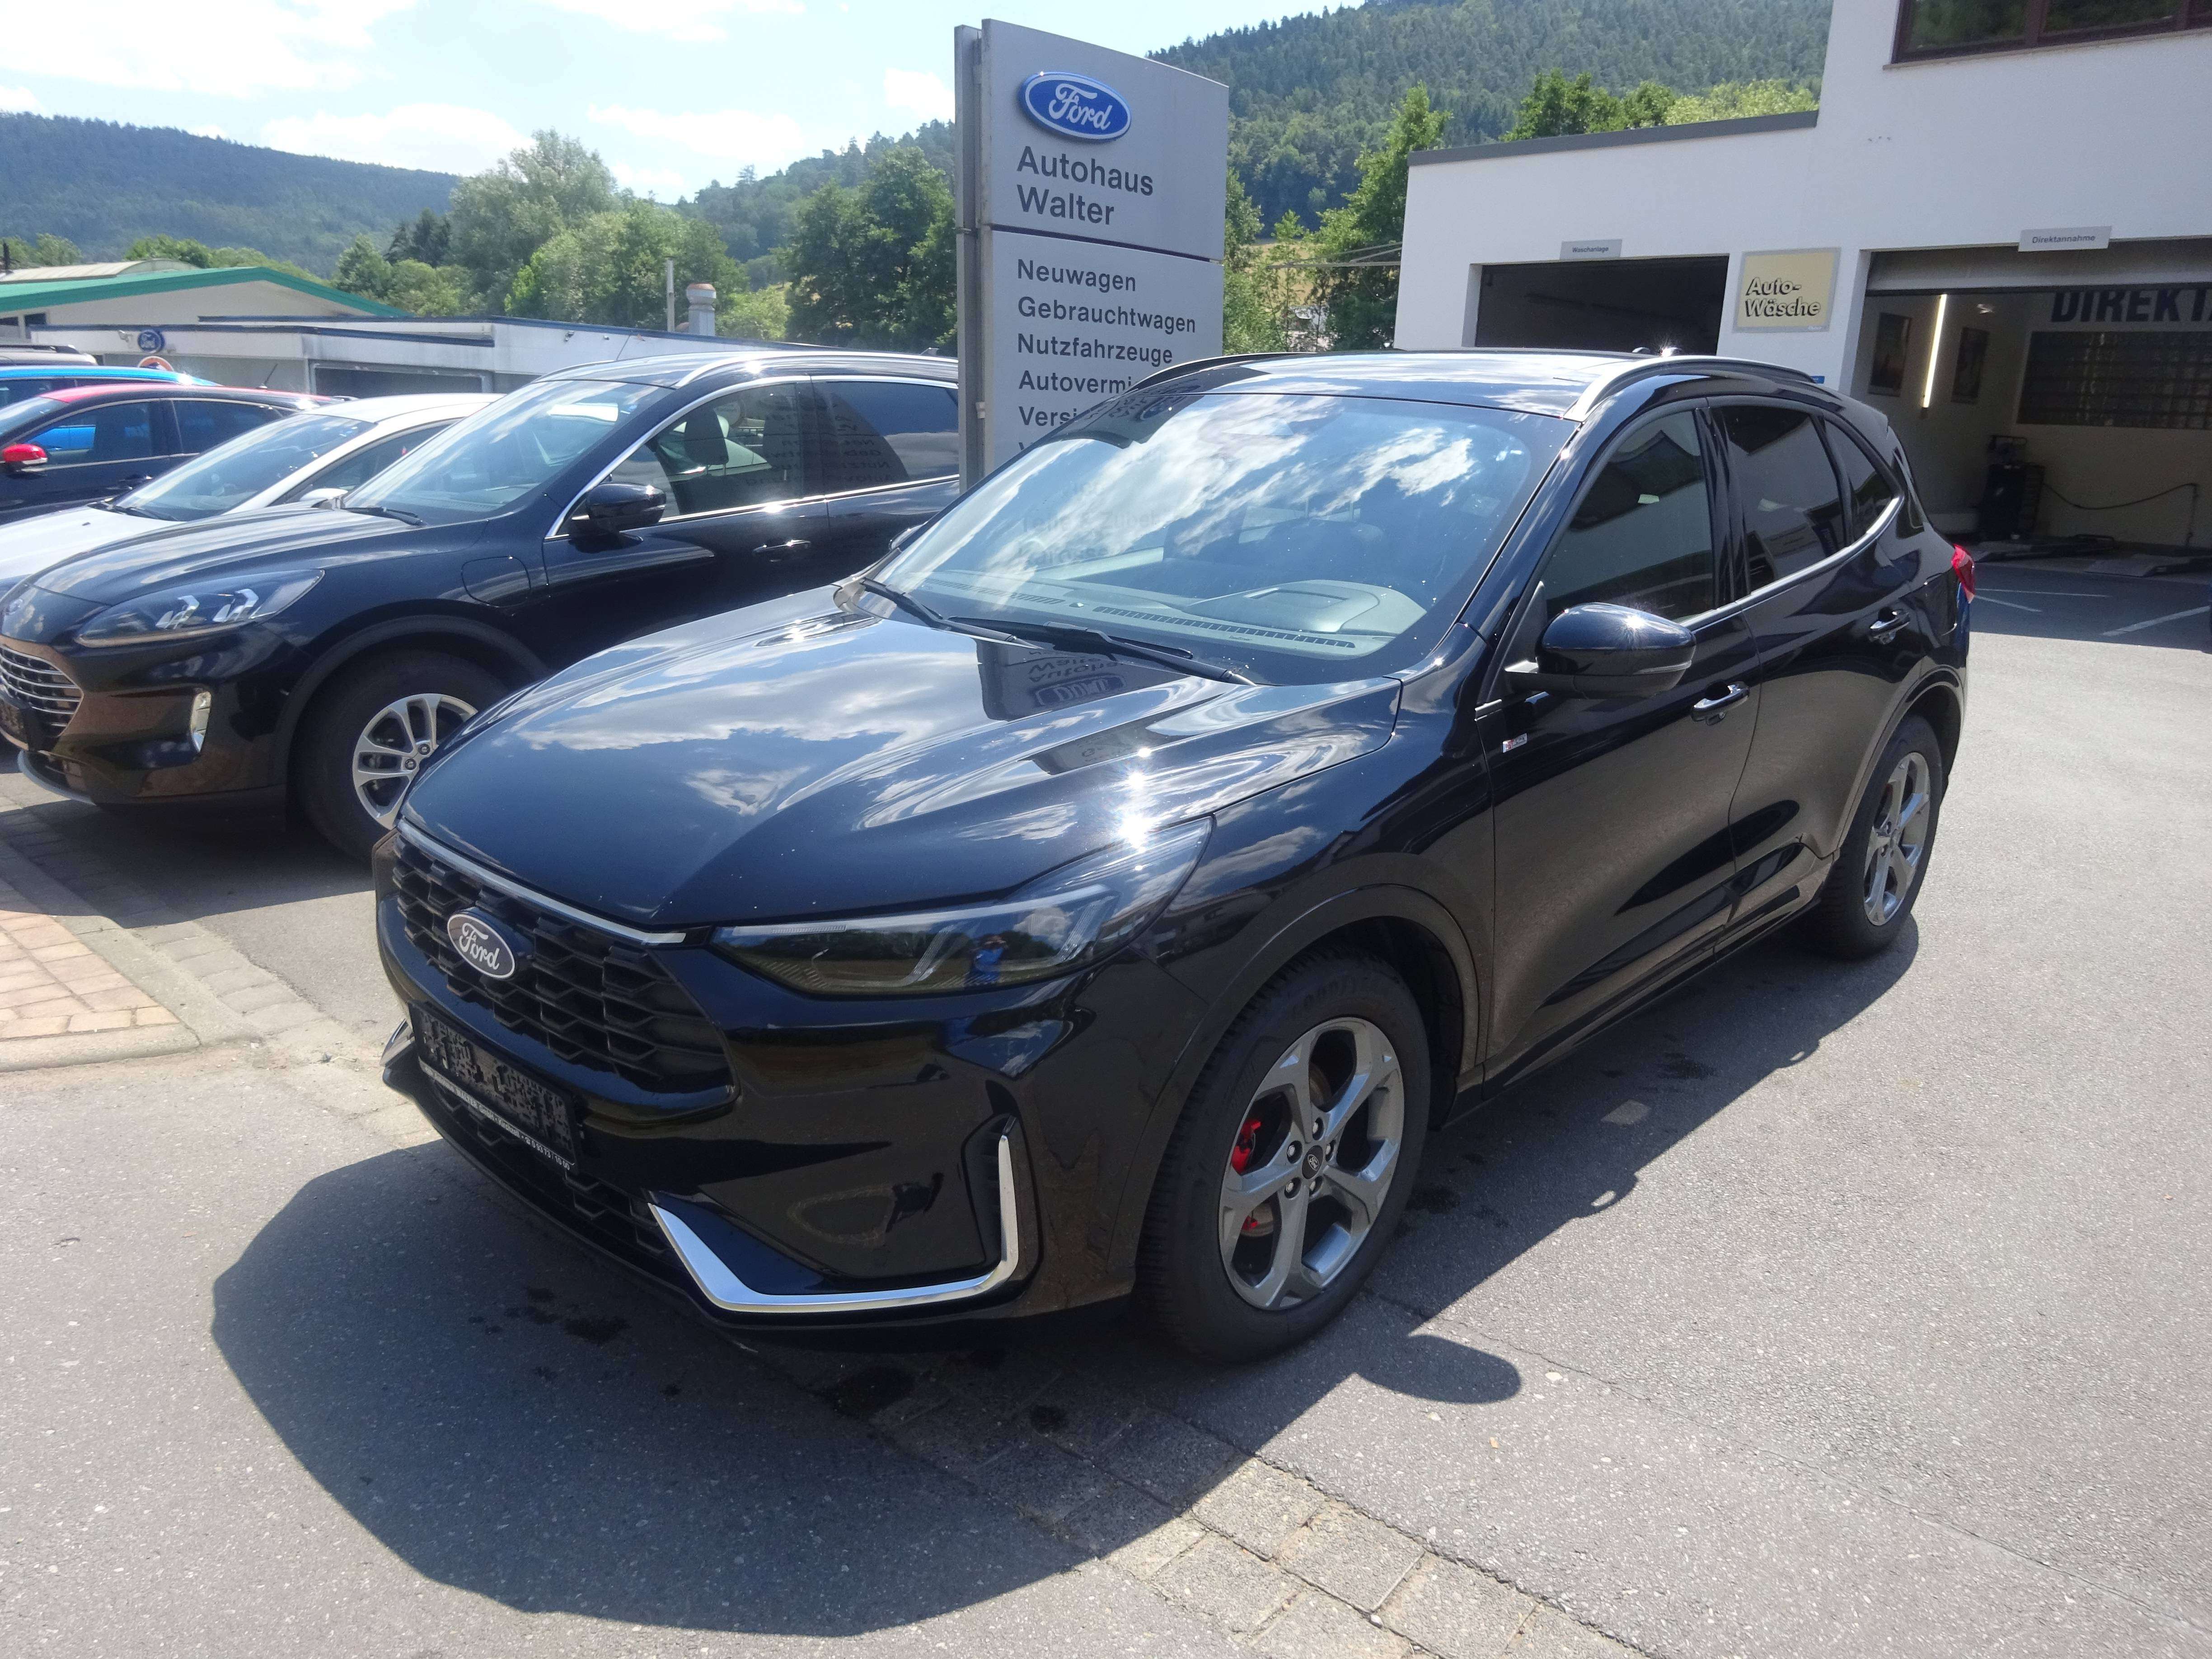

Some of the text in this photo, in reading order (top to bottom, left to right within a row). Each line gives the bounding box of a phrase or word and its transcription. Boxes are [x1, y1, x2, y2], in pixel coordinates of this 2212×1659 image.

[1048, 83, 1113, 130] Ford
[1016, 145, 1153, 196] Autohaus
[1017, 184, 1114, 225] Walter
[2033, 235, 2095, 243] Direktannahme
[1017, 259, 1136, 292] Neuwagen
[1745, 276, 1802, 295] Auto-
[1018, 296, 1195, 335] Gebrauchtwagen
[1745, 296, 1821, 317] Wäsche
[2051, 288, 2212, 322] DIREKT
[1017, 333, 1173, 366] Nutzfahrzeuge
[1018, 370, 1131, 394] Autovermi
[1018, 406, 1077, 426] Versi
[459, 922, 501, 971] Ford
